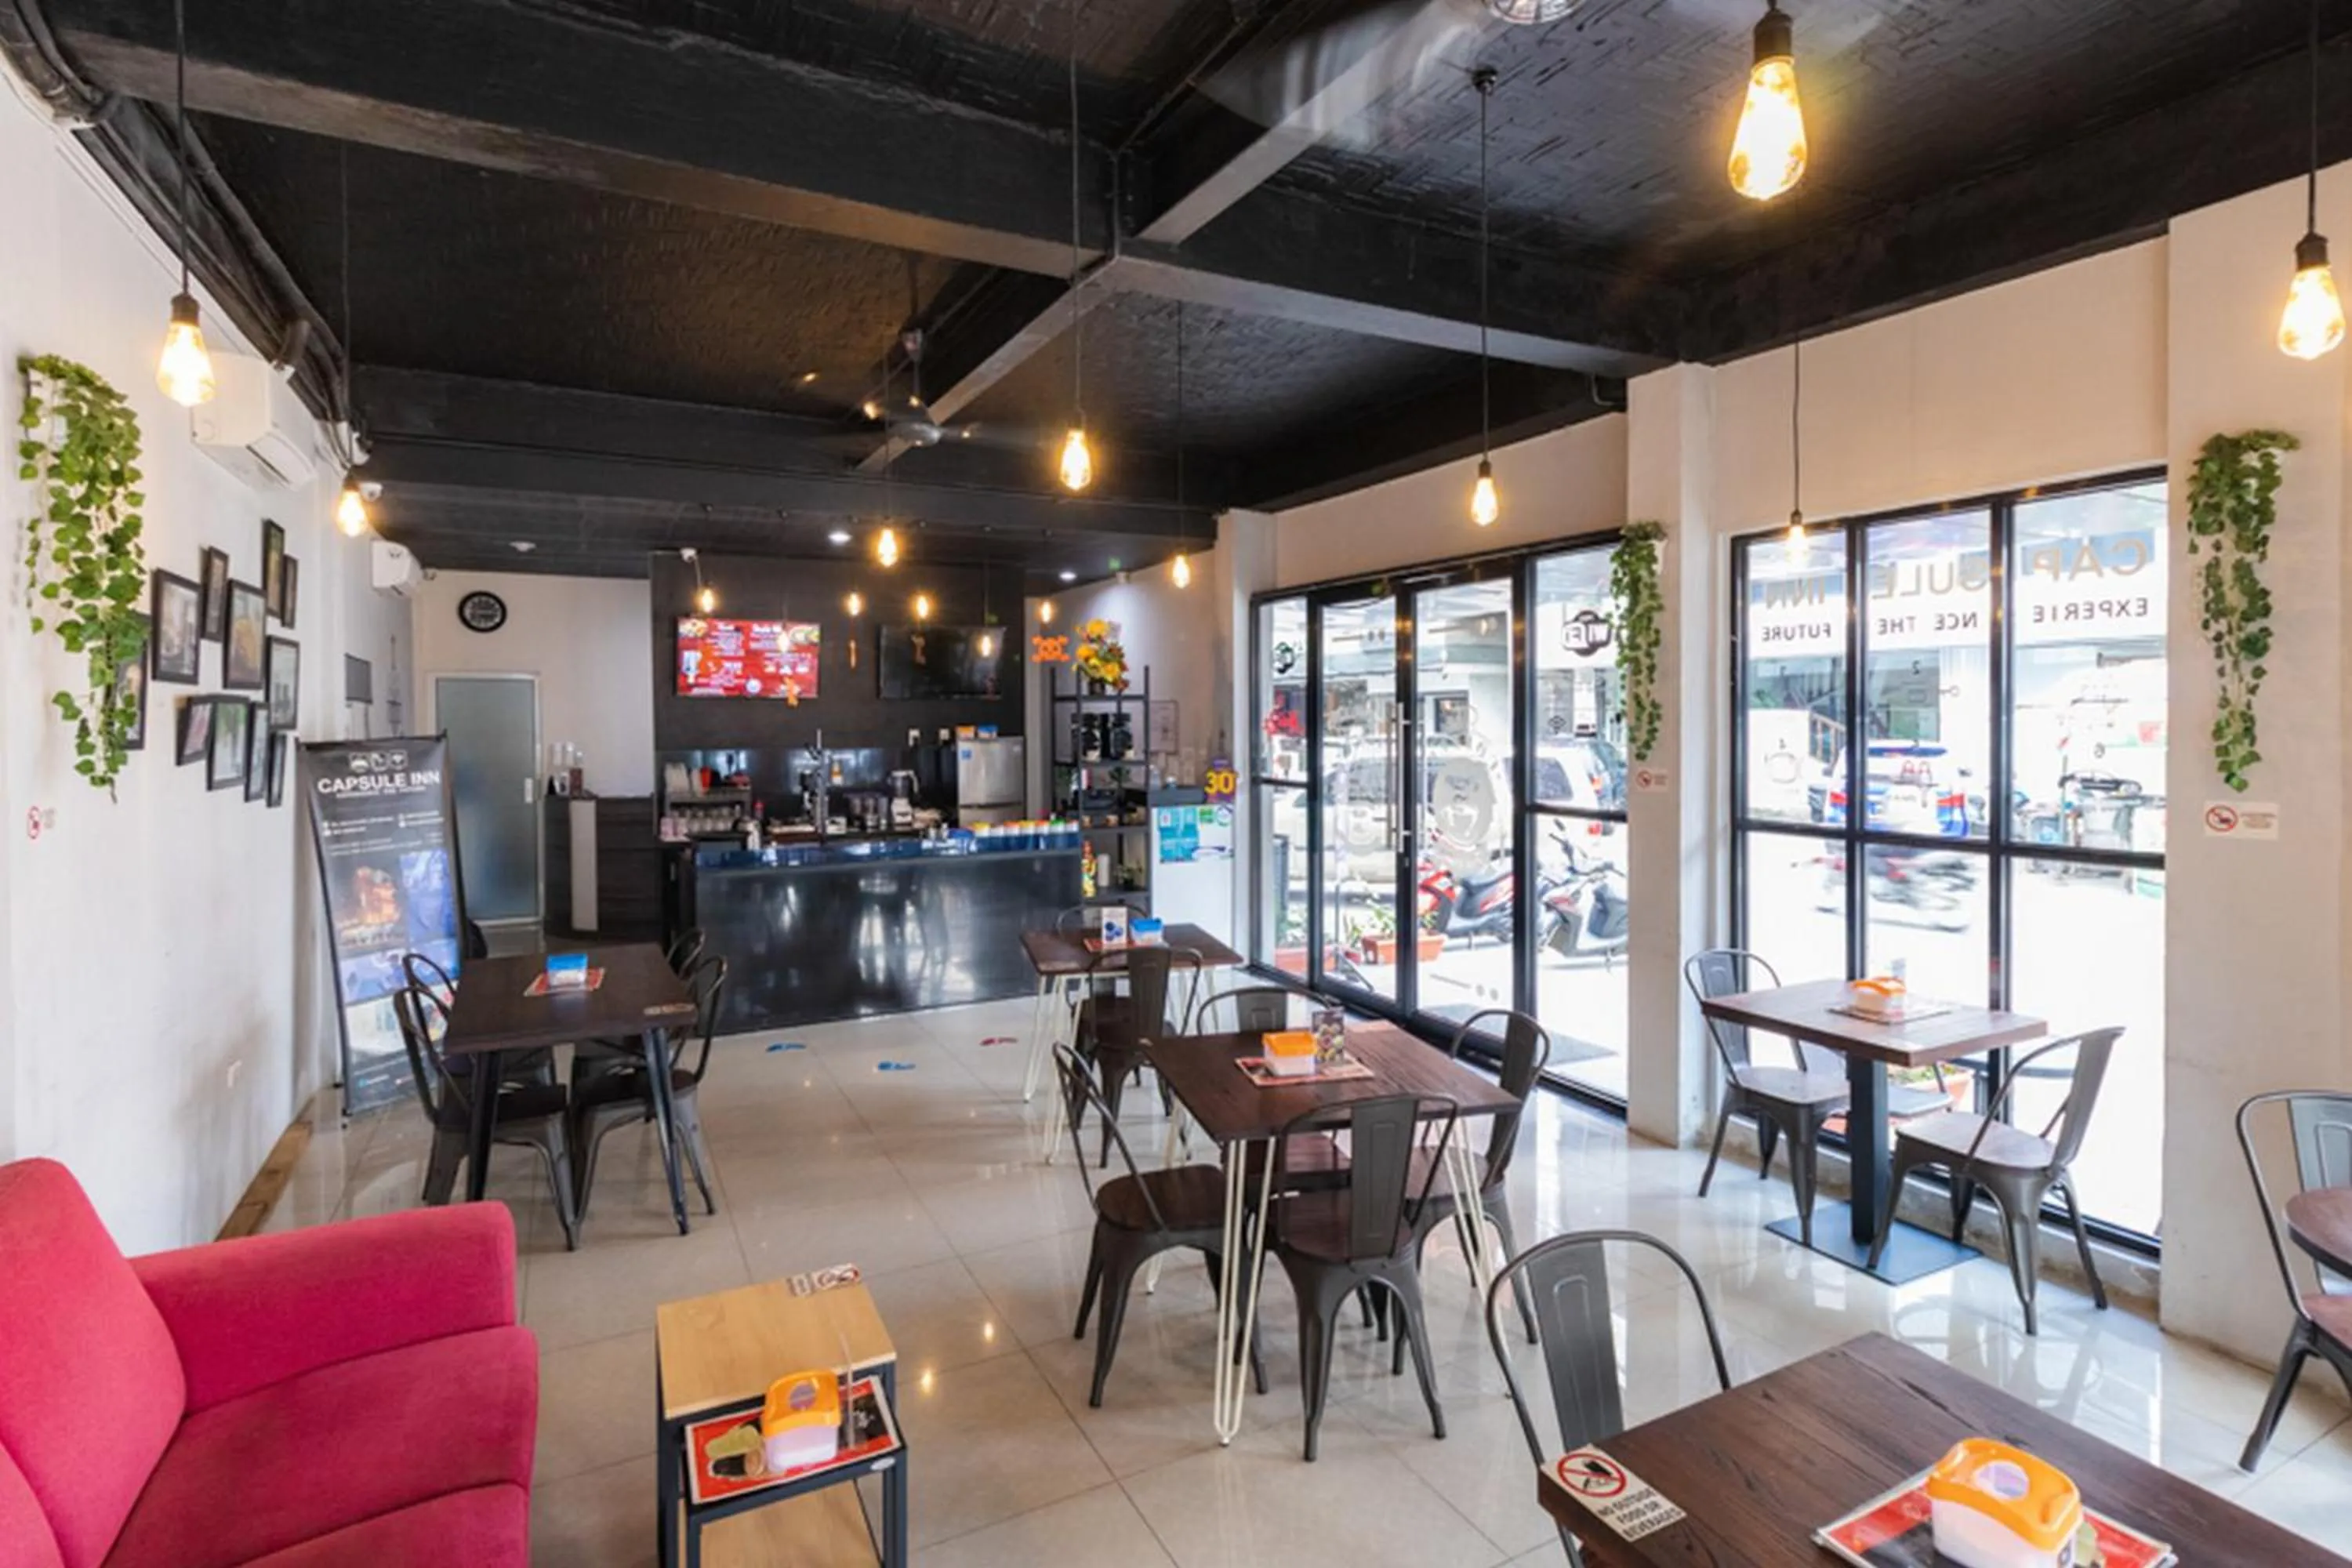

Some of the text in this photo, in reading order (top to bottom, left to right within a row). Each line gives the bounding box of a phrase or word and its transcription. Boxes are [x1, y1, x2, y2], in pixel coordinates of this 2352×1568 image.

[318, 772, 406, 793] CAPSULE
[410, 770, 440, 785] INN
[1204, 770, 1235, 794] 30
